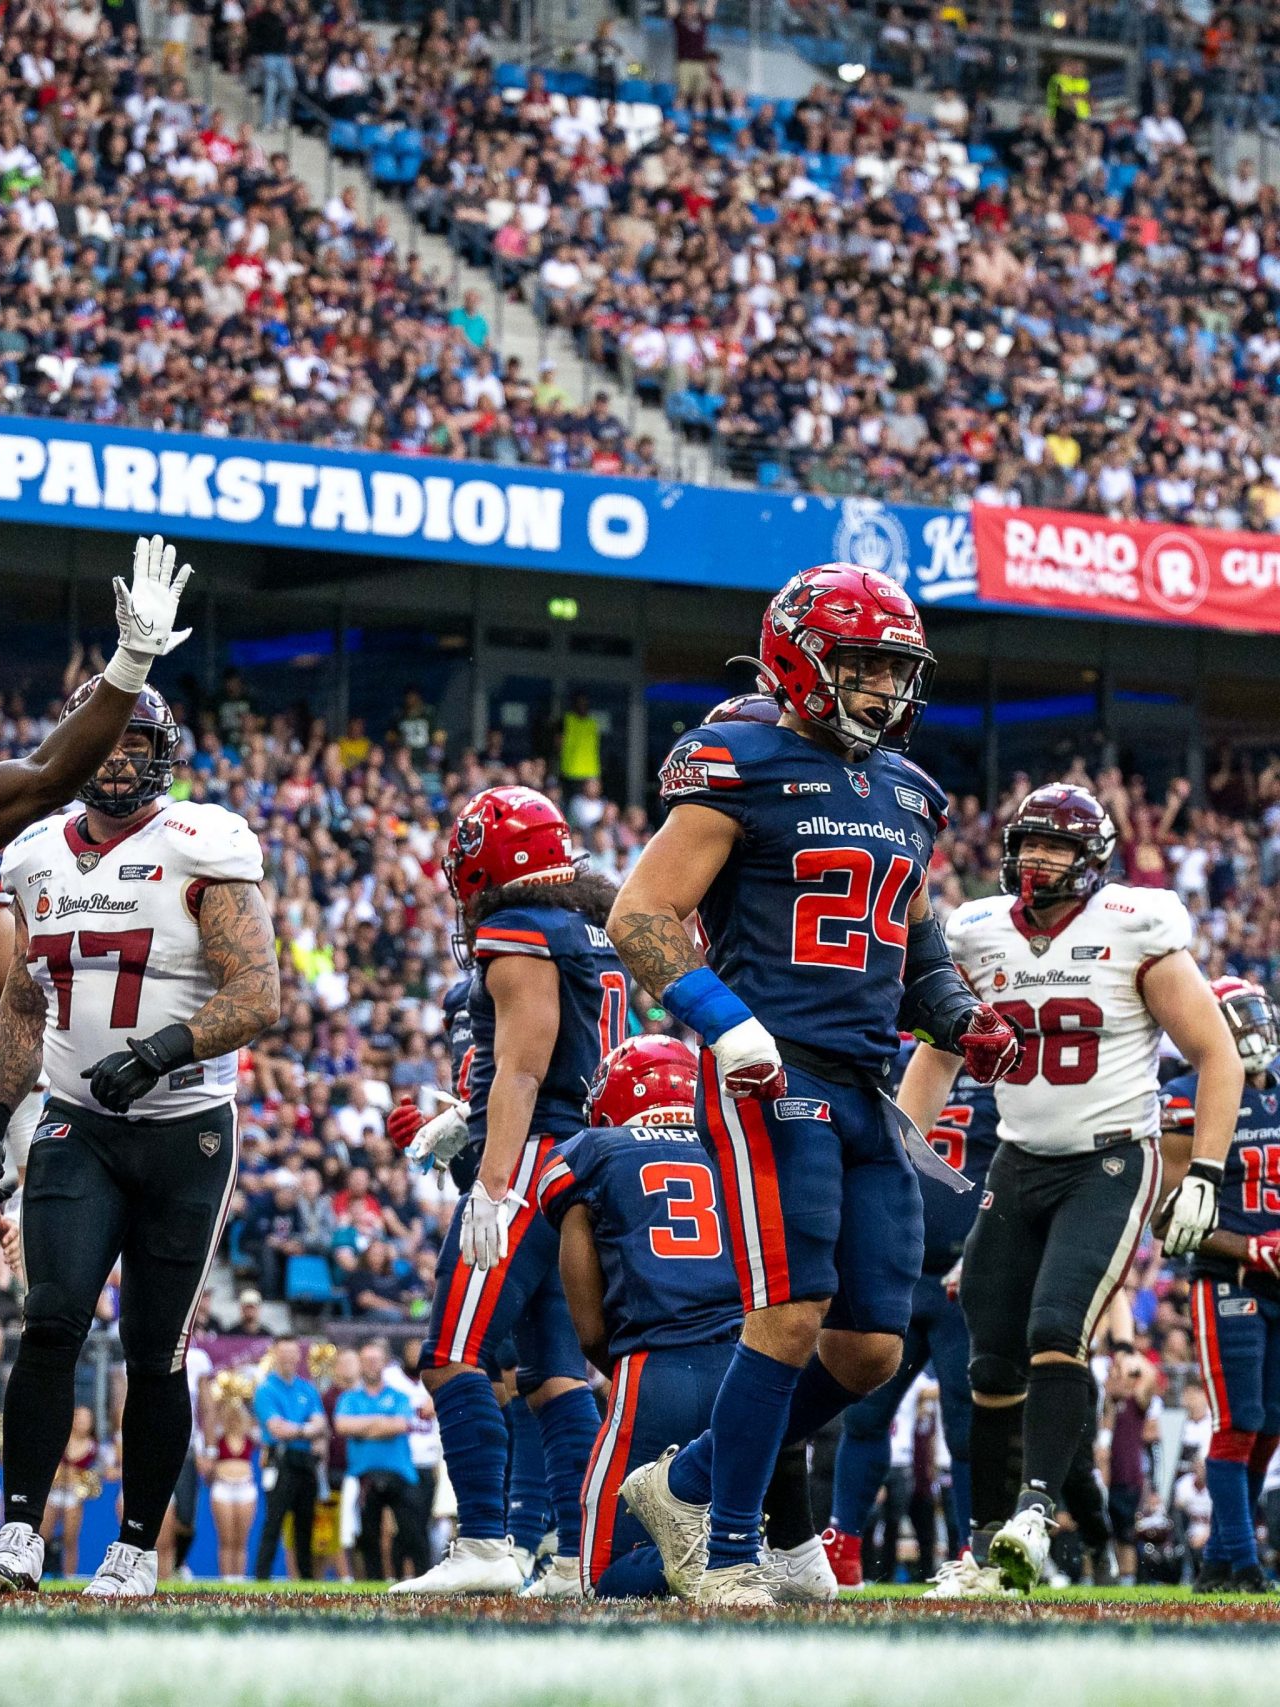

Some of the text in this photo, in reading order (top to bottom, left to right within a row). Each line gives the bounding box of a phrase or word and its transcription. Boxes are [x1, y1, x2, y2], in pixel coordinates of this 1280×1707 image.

[1004, 519, 1140, 573] RADIO
[796, 816, 907, 846] allbranded
[791, 846, 926, 984] 24
[26, 928, 154, 1031] 77
[641, 1111, 695, 1127] FOREL
[639, 1161, 722, 1259] 3
